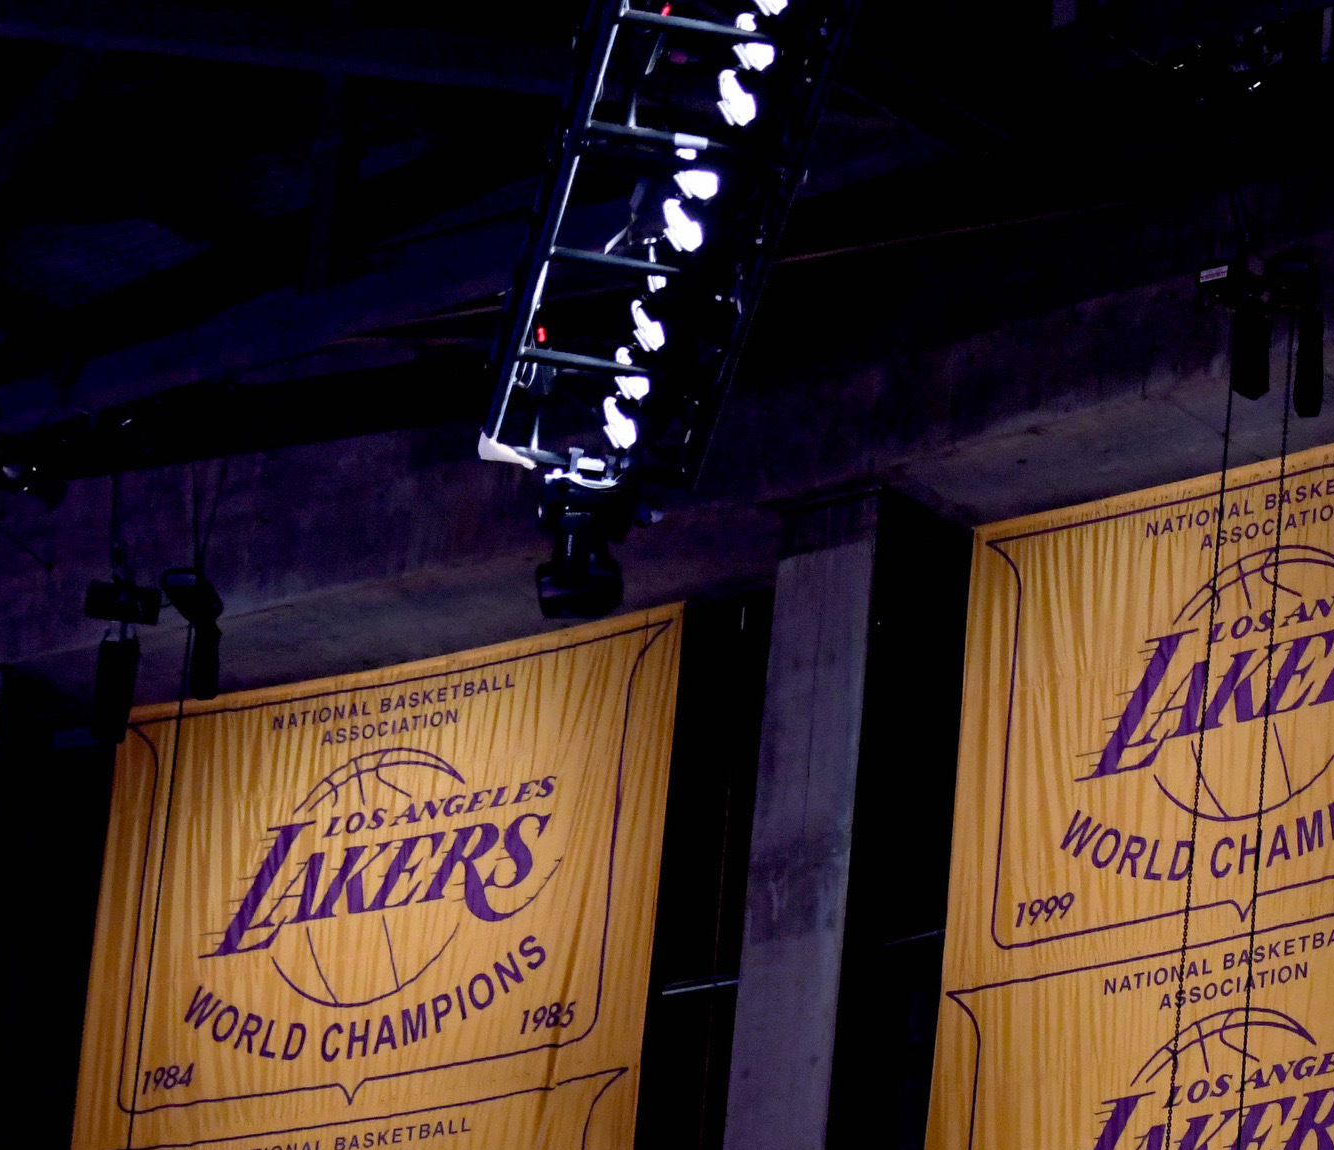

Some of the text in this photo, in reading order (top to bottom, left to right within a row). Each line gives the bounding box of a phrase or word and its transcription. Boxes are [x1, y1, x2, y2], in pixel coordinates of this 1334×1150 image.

[1146, 500, 1254, 538] NATIONAL
[1207, 614, 1271, 645] LOS
[272, 674, 515, 731] NATIONAL BASKETBALL
[321, 709, 458, 745] ASSOCIATION
[323, 776, 556, 837] LOS ANGELES
[1060, 810, 1194, 882] WORLD
[199, 812, 552, 958] LAKERS
[1015, 892, 1074, 928] 1999
[1104, 956, 1212, 995] NATIONAL
[1159, 962, 1309, 1011] ASSOCIATION
[184, 934, 547, 1063] WORLD CHAMPIONS
[520, 1003, 575, 1034] 1985
[142, 1063, 194, 1094] 1984
[1163, 1078, 1230, 1109] LOS
